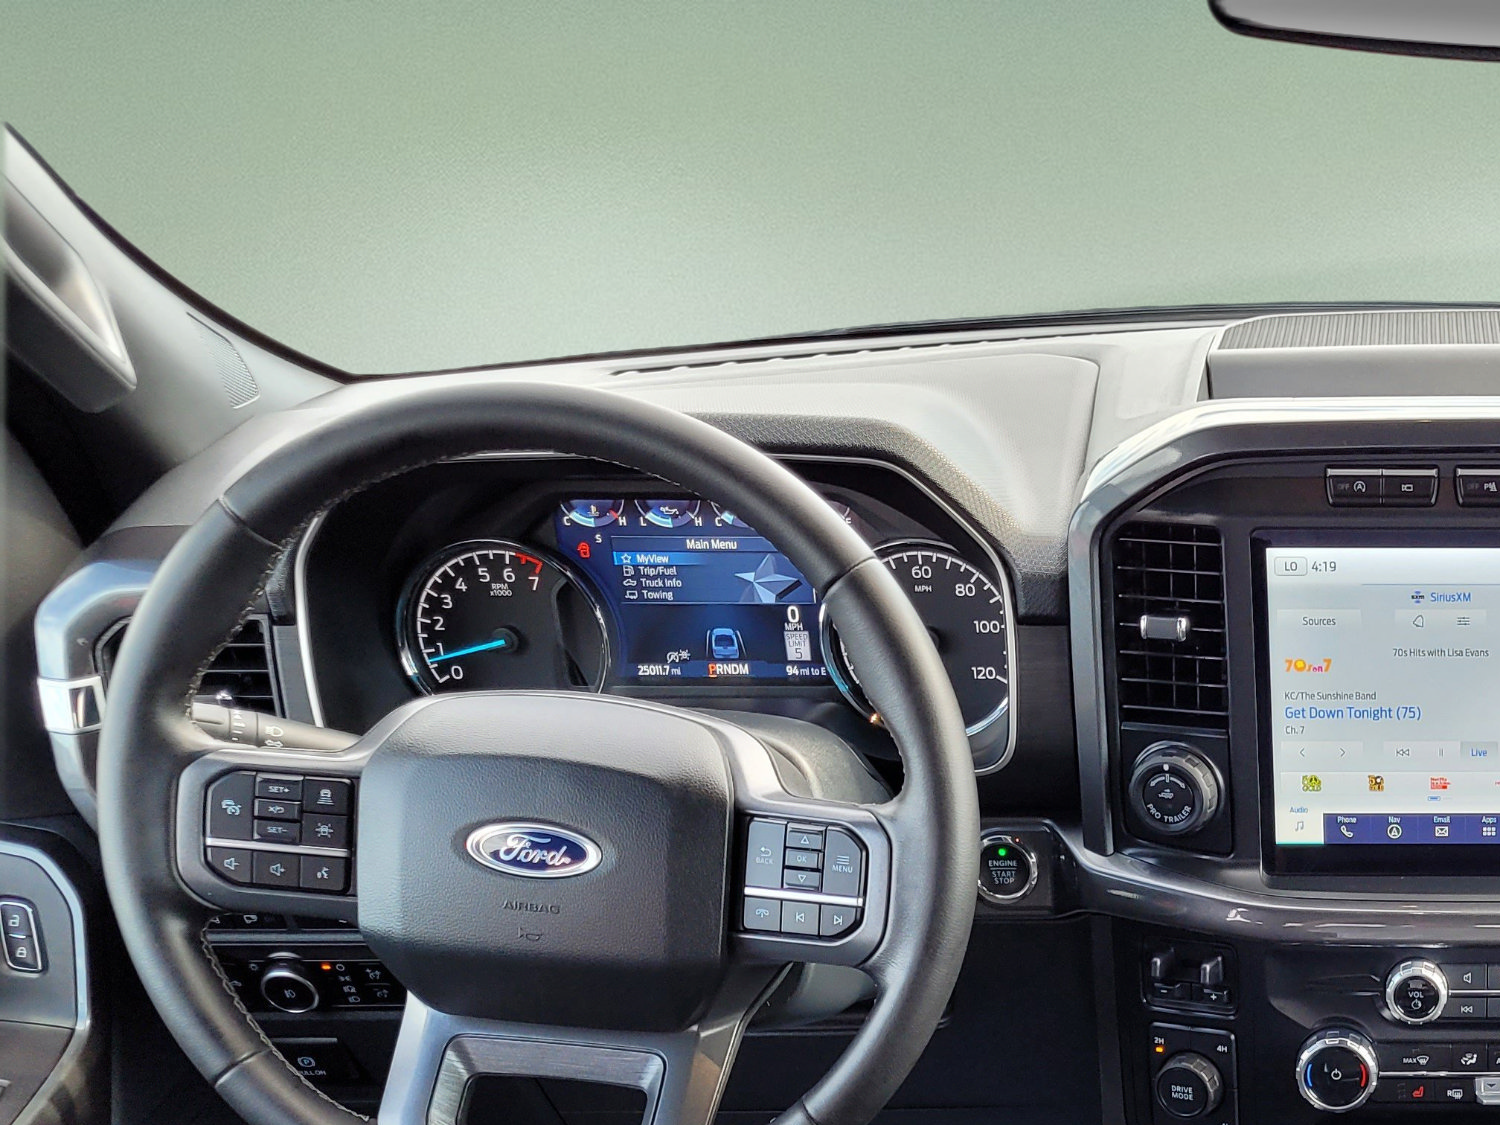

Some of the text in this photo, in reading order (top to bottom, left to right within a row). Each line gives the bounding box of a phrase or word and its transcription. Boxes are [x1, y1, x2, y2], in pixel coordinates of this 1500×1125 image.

[686, 538, 738, 550] Main Menu
[636, 553, 669, 564] MyView
[638, 565, 677, 577] Trip/Fuel
[911, 565, 932, 579] 60
[1284, 561, 1298, 572] LO
[1311, 560, 1337, 573] 4:19
[477, 568, 490, 583] 5
[503, 568, 515, 582] 6
[455, 578, 467, 592] 4
[528, 577, 539, 591] 7
[640, 578, 682, 588] Truck Info
[914, 584, 932, 592] MPH
[642, 590, 673, 601] Towing
[955, 583, 976, 597] 80
[441, 594, 453, 609] 3
[1430, 592, 1472, 603] SiriusXM
[787, 605, 800, 623] 0
[432, 616, 445, 630] 2
[1302, 616, 1337, 626] Sources
[784, 623, 804, 631] MPH
[973, 620, 999, 634] 100
[785, 633, 808, 641] SPEED
[788, 640, 807, 648] LIMIT
[1392, 648, 1490, 657] 70s Hits with Lisa Evans
[451, 665, 463, 680] 0
[637, 665, 670, 676] 25011.7
[786, 664, 799, 676] 94
[811, 666, 820, 676] to
[971, 666, 996, 680] 120
[1284, 691, 1377, 701] KC/The Sunshine Band
[1285, 706, 1421, 721] Get Down Tonight (75)
[1285, 725, 1305, 735] Ch. 7
[1471, 747, 1488, 757] Live
[1146, 803, 1192, 823] PRO TRAILER
[1481, 816, 1497, 825] Apps
[499, 834, 571, 866] Ford
[755, 857, 773, 865] BACK
[796, 854, 807, 863] OK
[832, 865, 853, 874] MENU
[503, 901, 560, 915] AIRBAG
[1408, 991, 1424, 999] VOL
[1154, 1037, 1164, 1045] 2H
[1217, 1044, 1228, 1053] 4H
[1171, 1085, 1193, 1093] DRIVE
[1171, 1092, 1194, 1100] MODE
